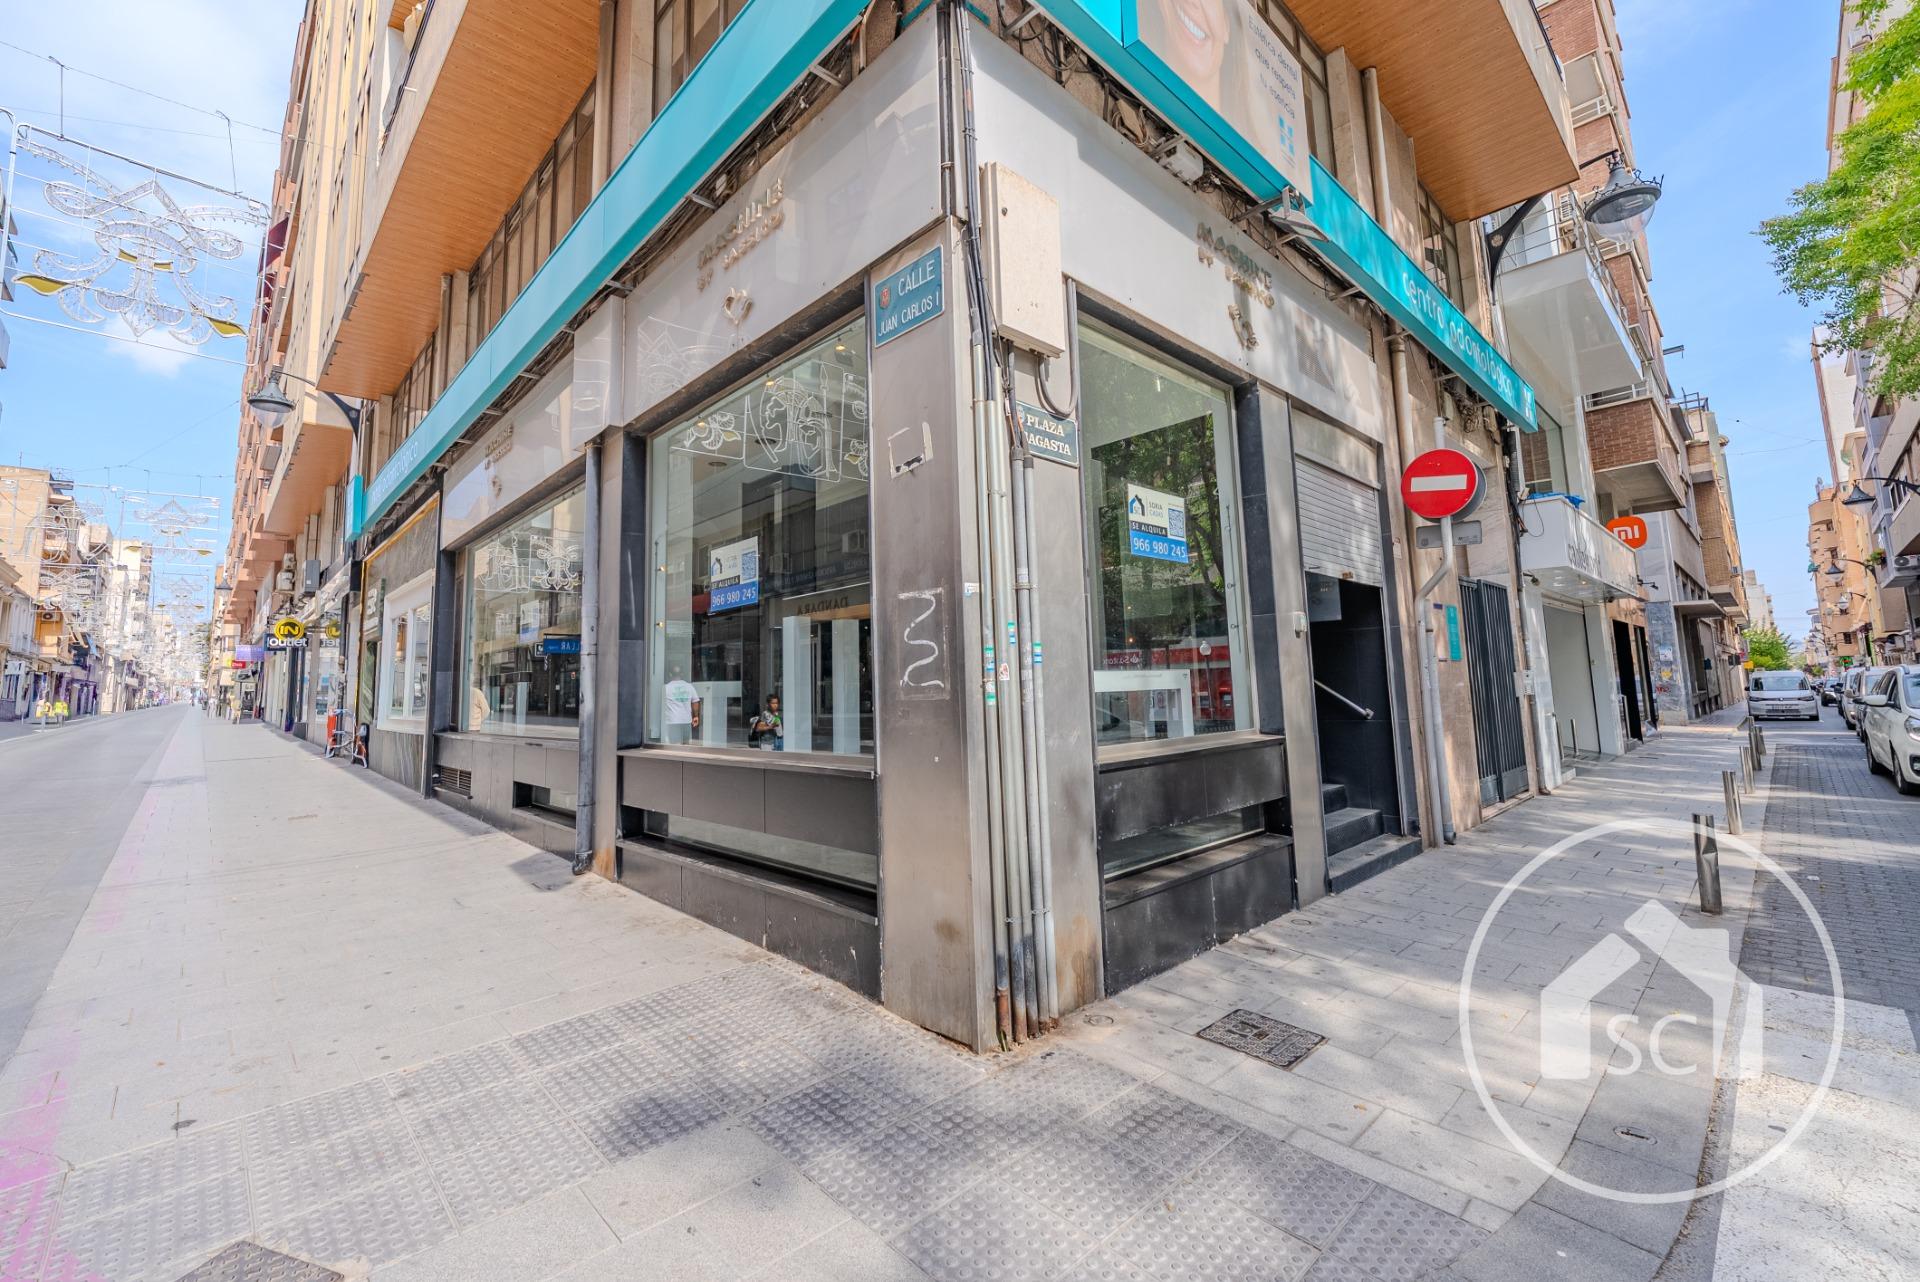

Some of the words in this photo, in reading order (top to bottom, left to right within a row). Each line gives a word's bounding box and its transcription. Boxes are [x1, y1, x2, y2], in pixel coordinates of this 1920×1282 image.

[1254, 48, 1269, 70] que
[1271, 67, 1296, 100] respeta
[1277, 50, 1298, 81] dental
[898, 259, 936, 296] CALLE
[878, 314, 898, 337] JUAN
[901, 295, 933, 324] CARLOS
[1402, 272, 1445, 329] centro
[1449, 321, 1513, 397] odontológico
[1026, 414, 1065, 437] PLAZA
[1132, 521, 1140, 530] SE
[1141, 524, 1166, 535] ALQUILA
[1133, 537, 1150, 552] 966
[1152, 541, 1168, 554] 980
[1170, 544, 1186, 558] 245
[712, 593, 725, 607] 966
[726, 590, 740, 604] 980
[742, 586, 756, 600] 245
